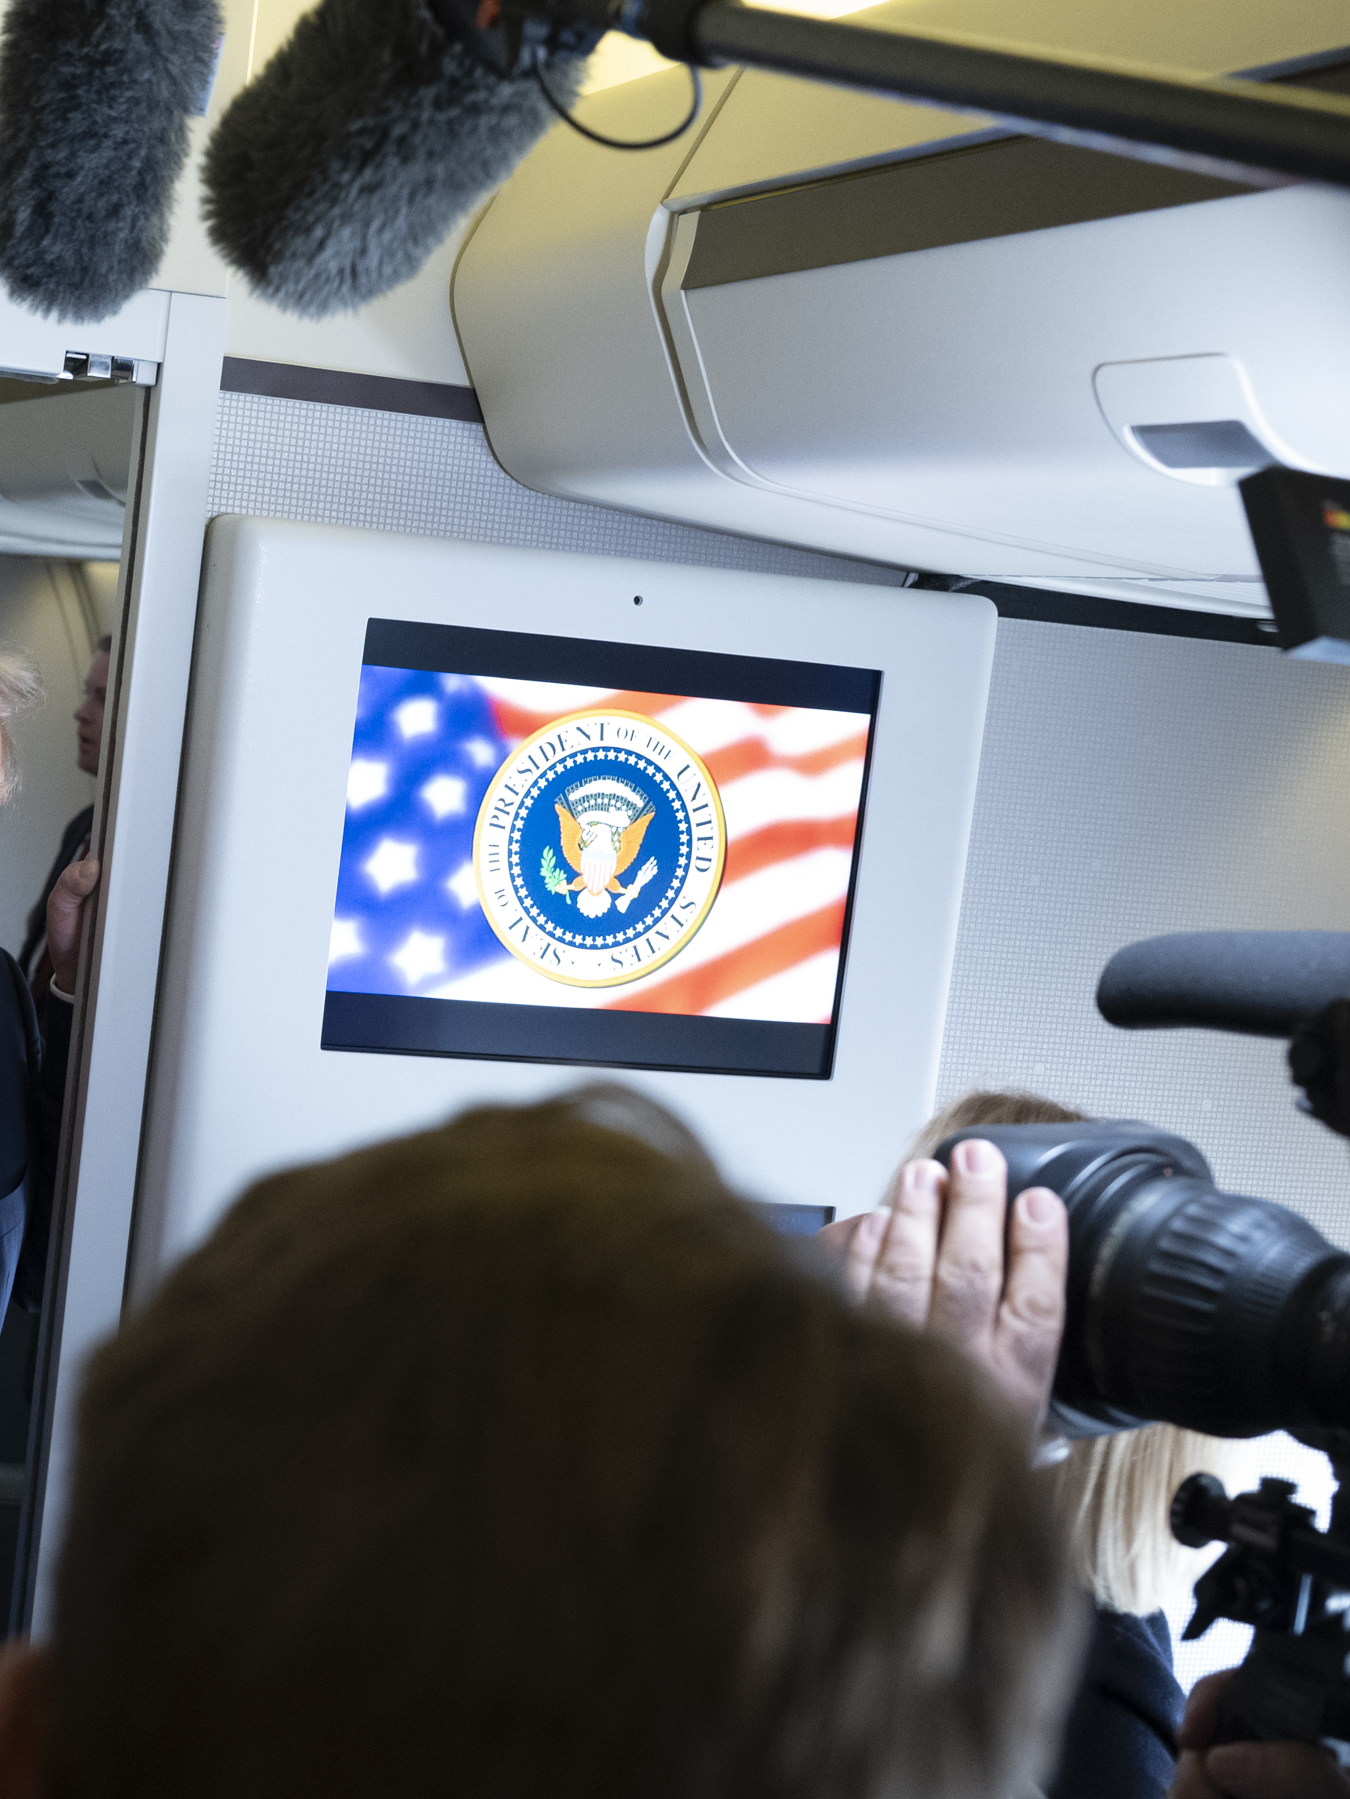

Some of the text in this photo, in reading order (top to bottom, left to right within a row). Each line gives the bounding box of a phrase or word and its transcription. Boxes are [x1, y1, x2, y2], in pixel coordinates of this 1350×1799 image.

[616, 726, 640, 743] OF
[644, 734, 676, 765] THE
[489, 722, 611, 830] PRESIDENT
[676, 763, 715, 873] UNITED
[507, 909, 567, 967] SEAL
[611, 896, 697, 970] STATES
